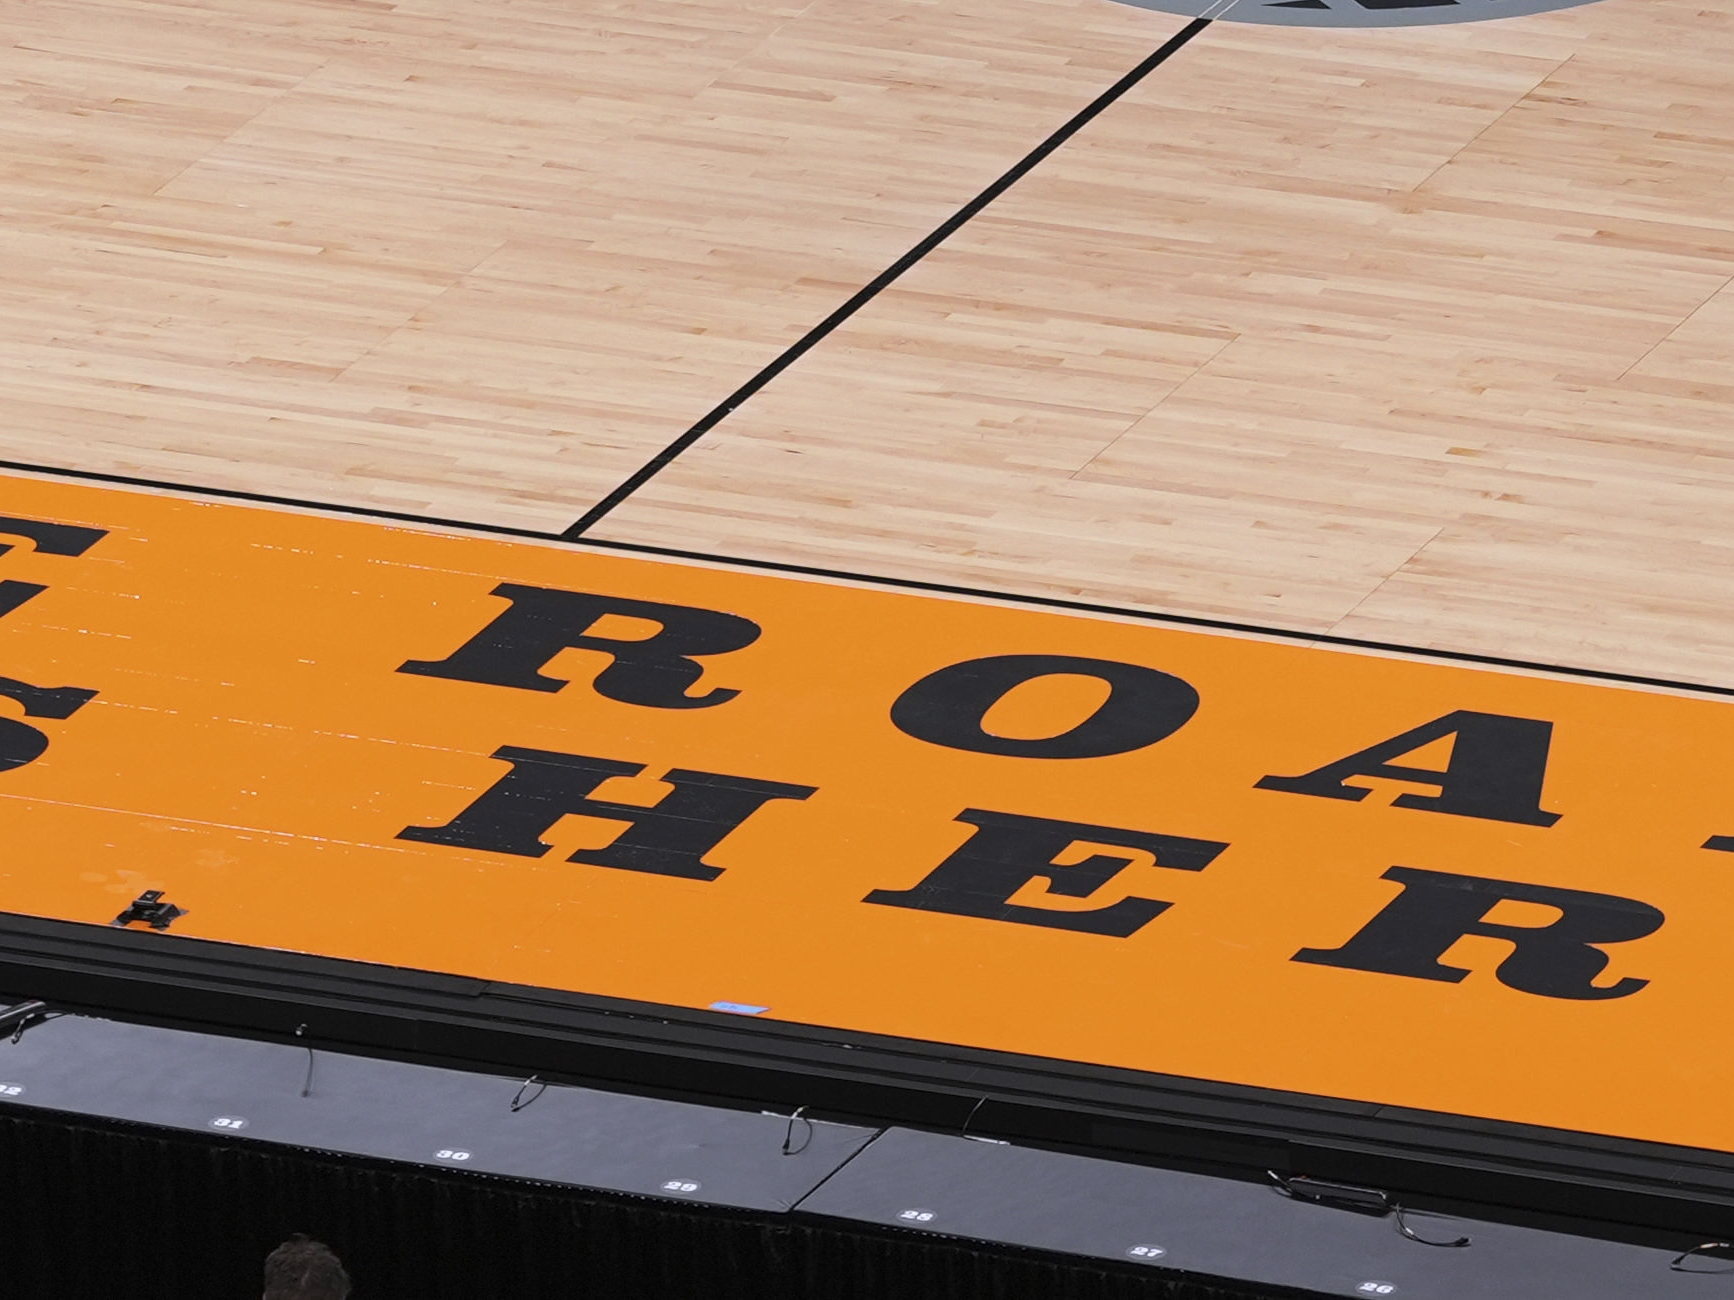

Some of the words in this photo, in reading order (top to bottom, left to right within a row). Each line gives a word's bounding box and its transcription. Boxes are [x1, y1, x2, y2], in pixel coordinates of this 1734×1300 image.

[214, 1119, 243, 1128] 31
[437, 1150, 469, 1160] 30
[664, 1182, 697, 1191] 29
[901, 1211, 932, 1220] 28
[1131, 1247, 1162, 1256] 27
[1360, 1283, 1393, 1293] 26
